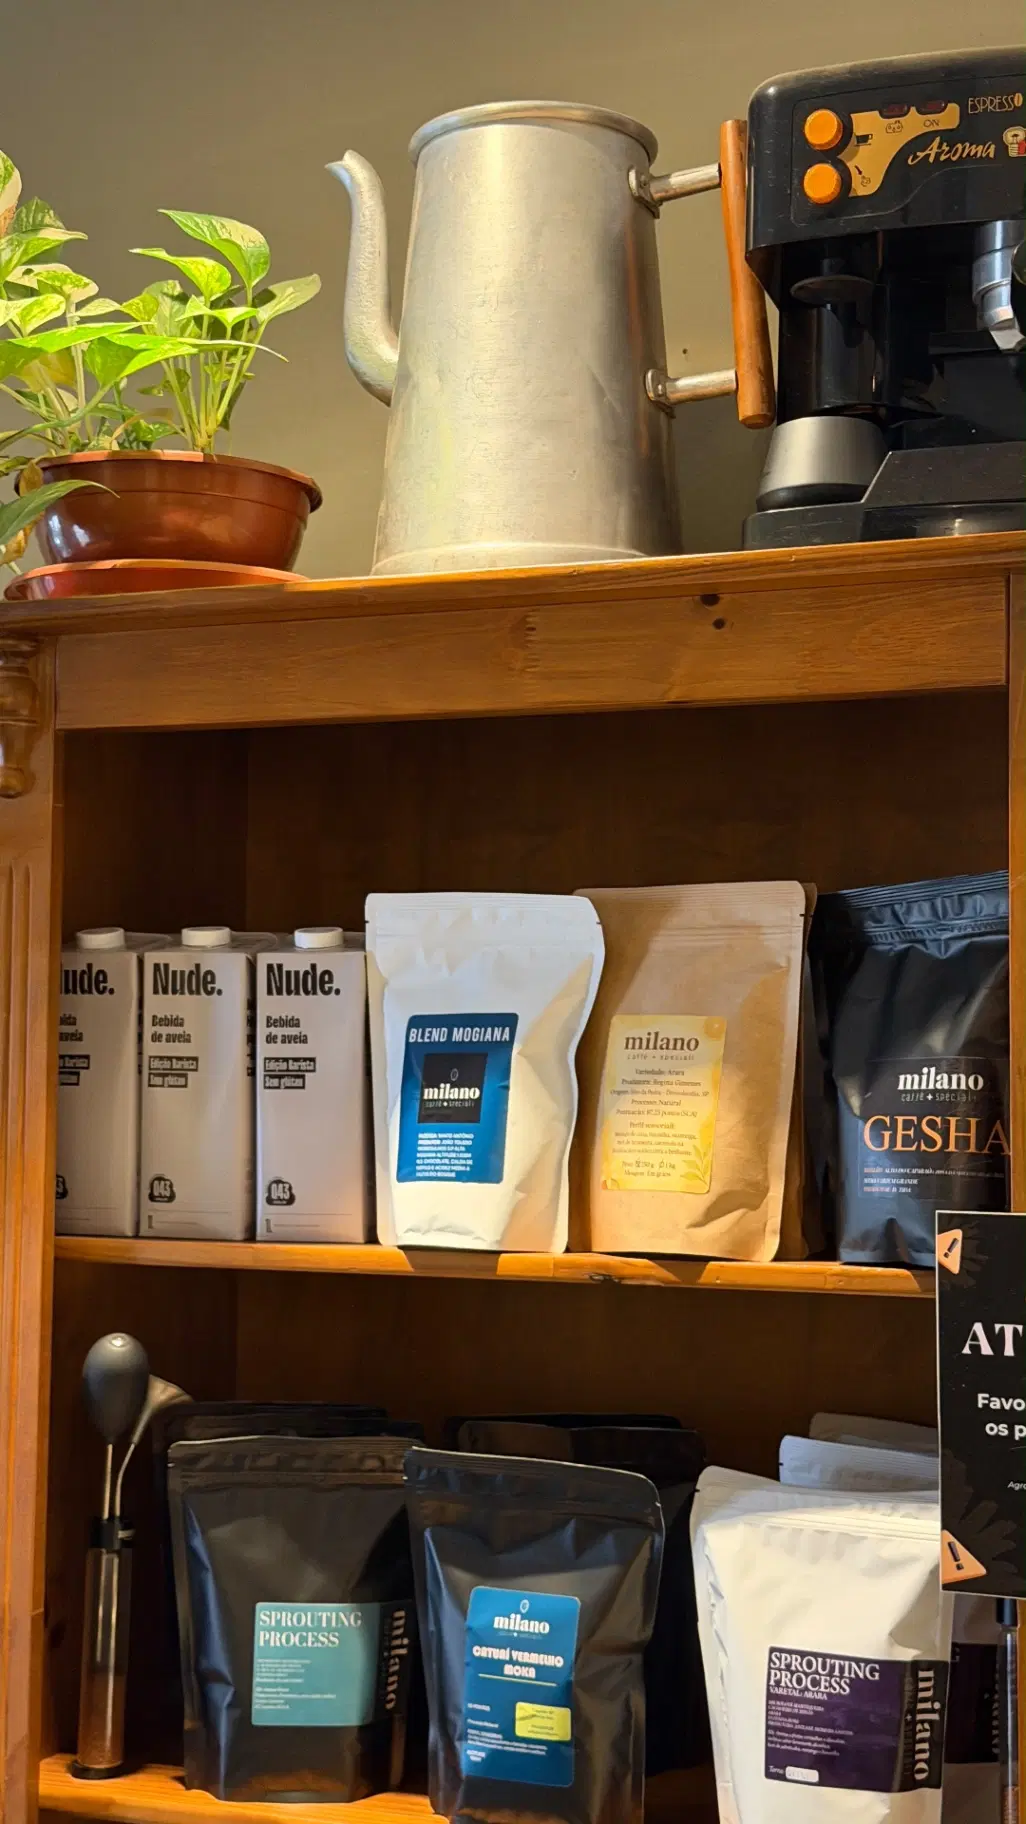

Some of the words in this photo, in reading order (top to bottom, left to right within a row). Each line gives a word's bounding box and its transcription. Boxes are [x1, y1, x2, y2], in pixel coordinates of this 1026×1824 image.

[968, 92, 1024, 114] ESPRESSO
[923, 119, 940, 128] ON
[907, 135, 996, 166] Aroma
[60, 962, 115, 996] ude.
[152, 962, 223, 997] Nude.
[265, 962, 341, 997] Nude.
[151, 1014, 185, 1028] Bebida
[266, 1014, 301, 1028] Bebida
[150, 1030, 164, 1044] de
[165, 1030, 192, 1044] aveia
[266, 1030, 278, 1044] de
[280, 1030, 308, 1045] aveia
[409, 1027, 448, 1043] BLEND
[452, 1026, 511, 1042] MOGIANA
[624, 1031, 700, 1053] milano
[266, 1059, 287, 1072] Edição
[288, 1059, 314, 1071] Barista
[265, 1076, 279, 1087] Sem
[280, 1076, 304, 1089] glúten
[897, 1066, 984, 1091] milano
[423, 1083, 481, 1100] milano
[863, 1115, 1011, 1155] GESHA
[270, 1183, 290, 1200] 043
[962, 1321, 1024, 1357] AT
[977, 1393, 1026, 1411] Favo
[985, 1422, 1009, 1437] os
[259, 1610, 363, 1629] SPROUTING
[493, 1612, 550, 1635] milano
[259, 1631, 340, 1648] PROCESS
[384, 1608, 410, 1711] milano
[512, 1649, 564, 1668] VERMELHO
[769, 1651, 880, 1681] SPROUTING
[503, 1664, 536, 1679] MOKA
[769, 1668, 851, 1696] PROCESS
[804, 1690, 828, 1701] ARARA
[913, 1669, 942, 1781] milano
